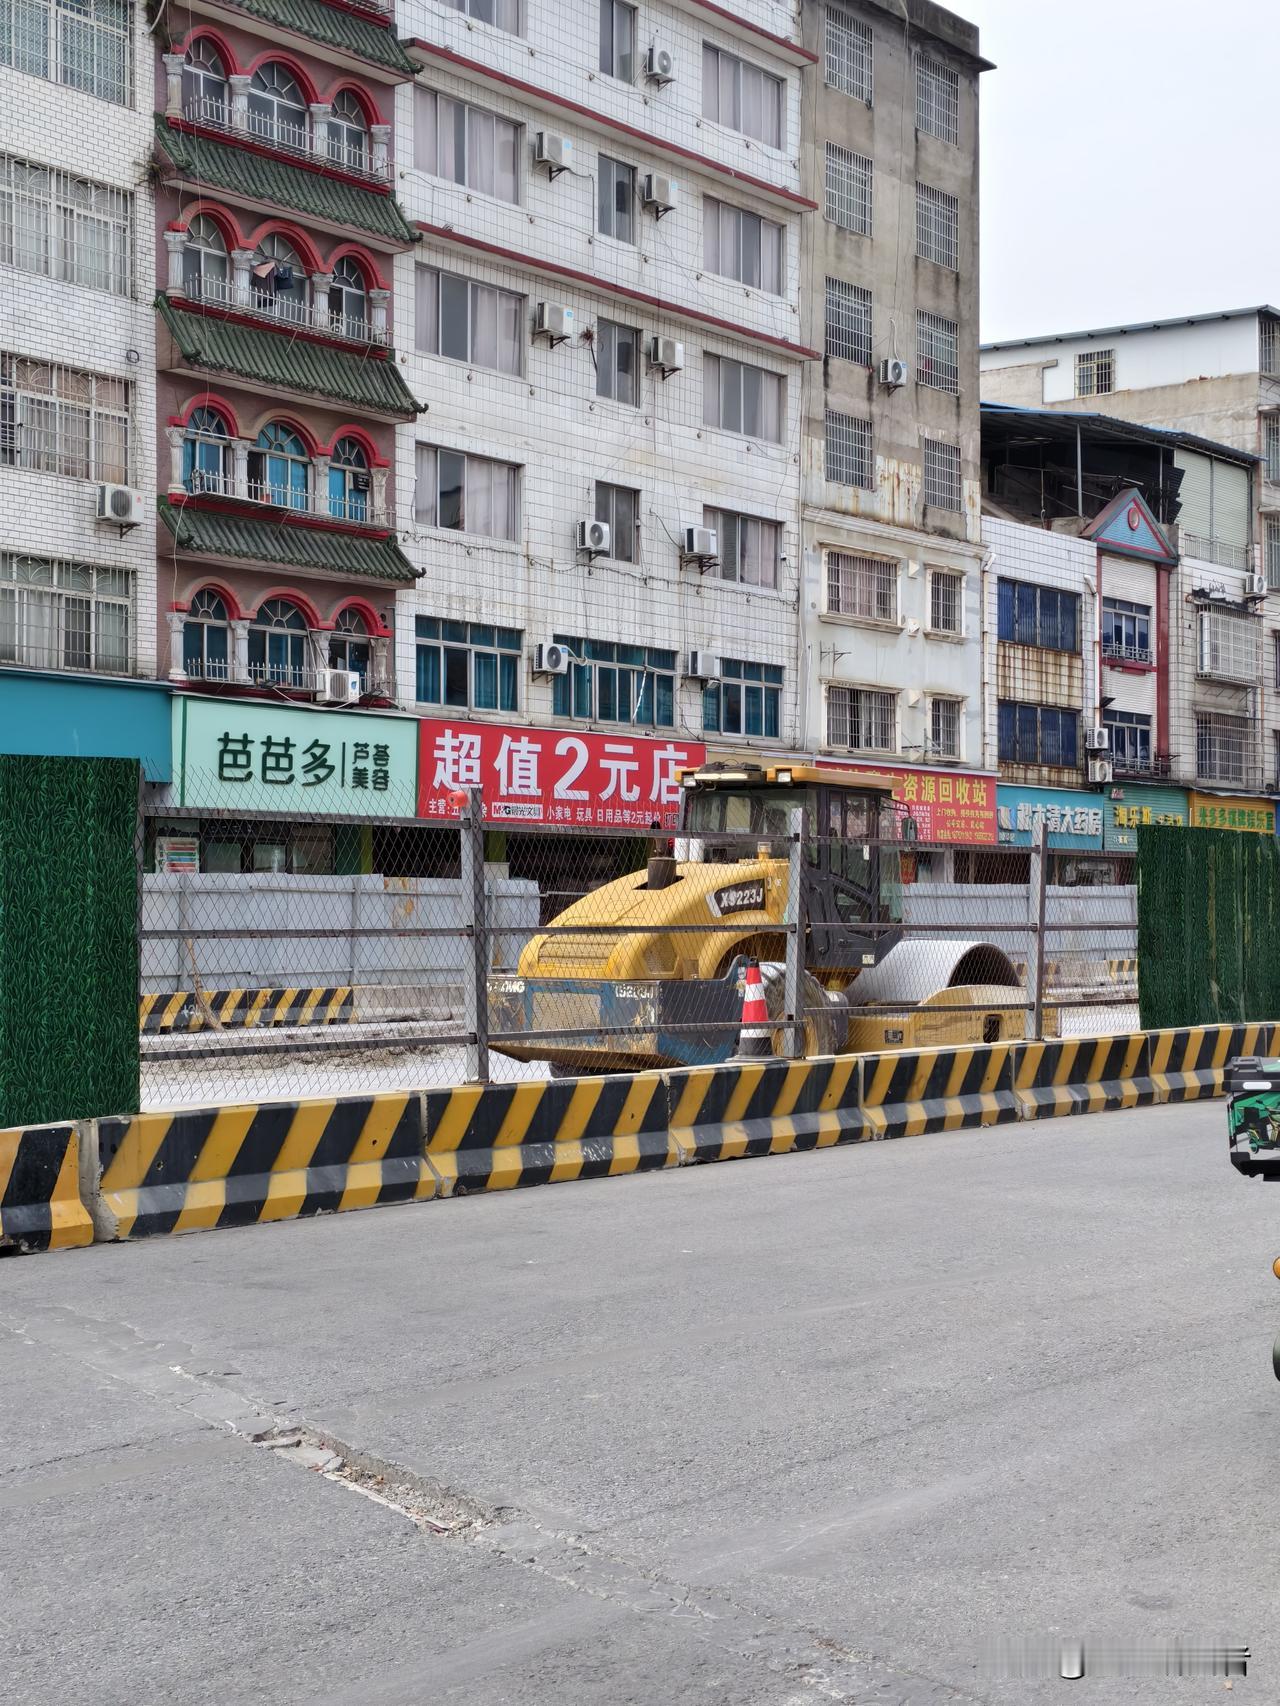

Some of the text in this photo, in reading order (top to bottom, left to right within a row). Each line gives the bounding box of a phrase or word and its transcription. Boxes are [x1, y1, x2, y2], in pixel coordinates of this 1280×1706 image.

[217, 731, 336, 788] 芭芭多
[352, 741, 390, 767] 芦荟
[432, 729, 688, 804] 超值2元店
[350, 766, 390, 791] 美容
[890, 774, 988, 807] 资源回收站
[546, 806, 572, 821] 小家电
[576, 808, 593, 822] 玩具
